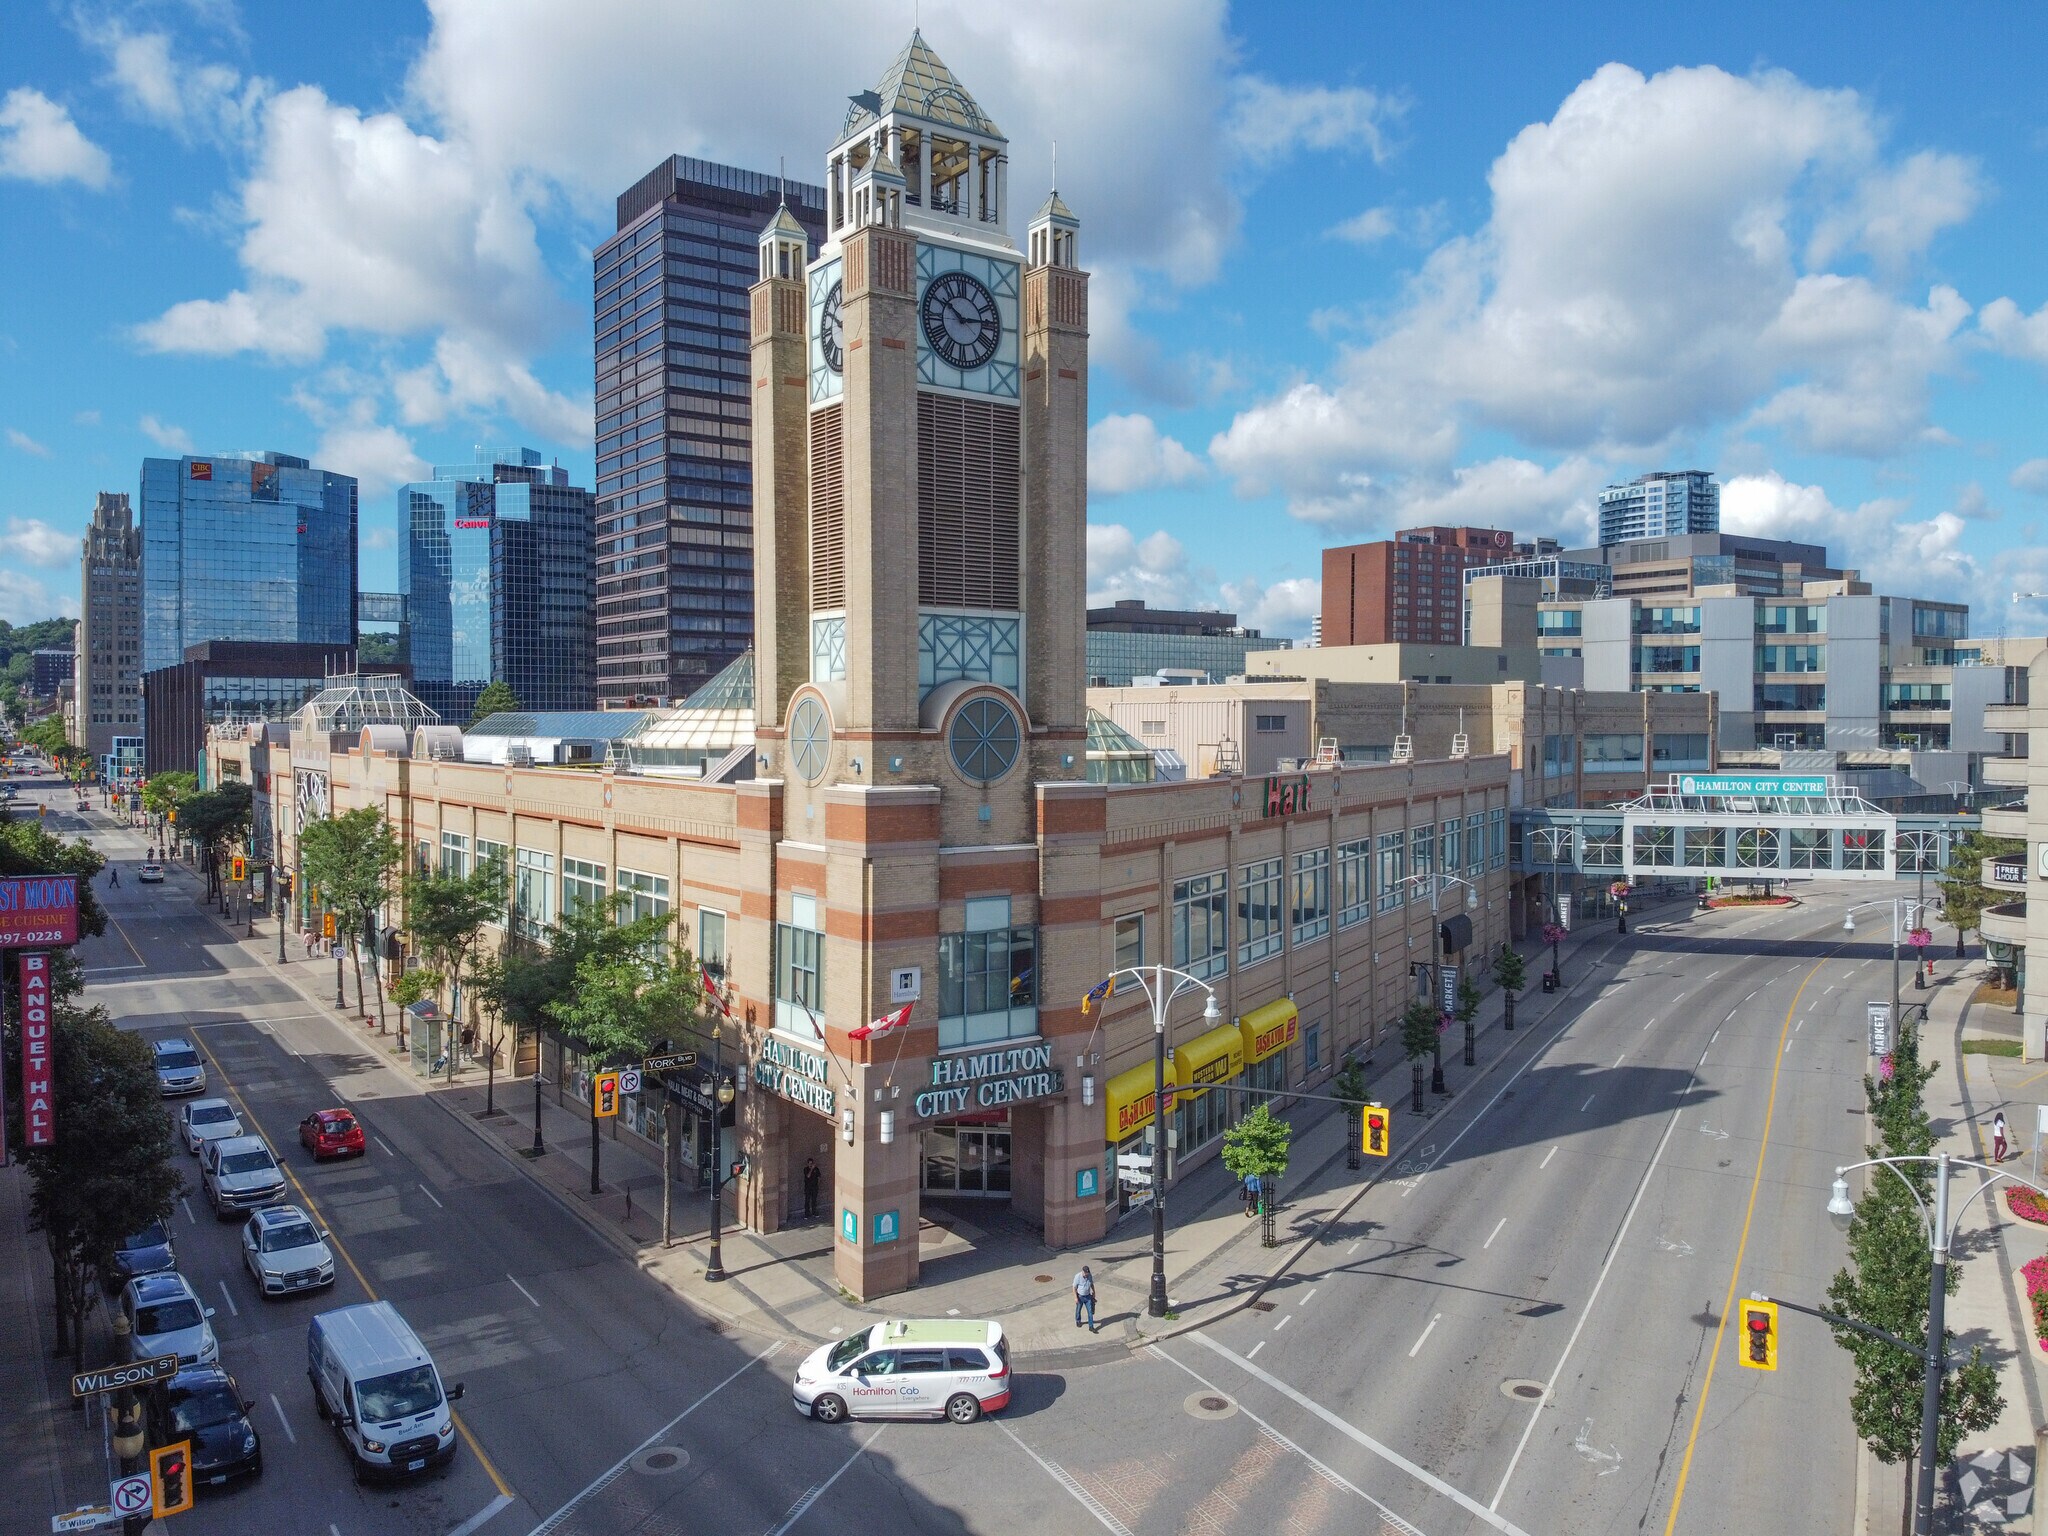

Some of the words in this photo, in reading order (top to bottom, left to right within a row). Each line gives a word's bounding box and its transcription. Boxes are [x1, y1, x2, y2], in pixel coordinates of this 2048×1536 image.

[192, 463, 211, 472] CIBC
[1263, 774, 1312, 818] Hart
[1695, 781, 1752, 792] HAMILTON
[1755, 782, 1779, 792] CITY
[1782, 782, 1824, 792] CENTRE
[2000, 866, 2019, 874] FREE
[2000, 873, 2019, 881] HOUR
[24, 879, 76, 910] MOON
[14, 913, 68, 926] CUISINE
[1444, 977, 1453, 1012] MARKET
[27, 957, 46, 1071] BANQUET
[1874, 1015, 1885, 1055] MARKET
[649, 1058, 676, 1069] YORK
[762, 1037, 828, 1084] HAMILTON
[932, 1045, 1052, 1086] HAMILTON
[755, 1062, 783, 1090] CITY
[783, 1073, 836, 1116] CENTRE
[915, 1087, 971, 1118] CITY
[977, 1071, 1065, 1108] CENTRE
[30, 1081, 48, 1144] HALL
[76, 1365, 154, 1392] WILSON
[159, 1359, 174, 1370] ST
[852, 1387, 897, 1396] Hamilton
[899, 1386, 920, 1395] Cab
[68, 1517, 96, 1528] Wilson
